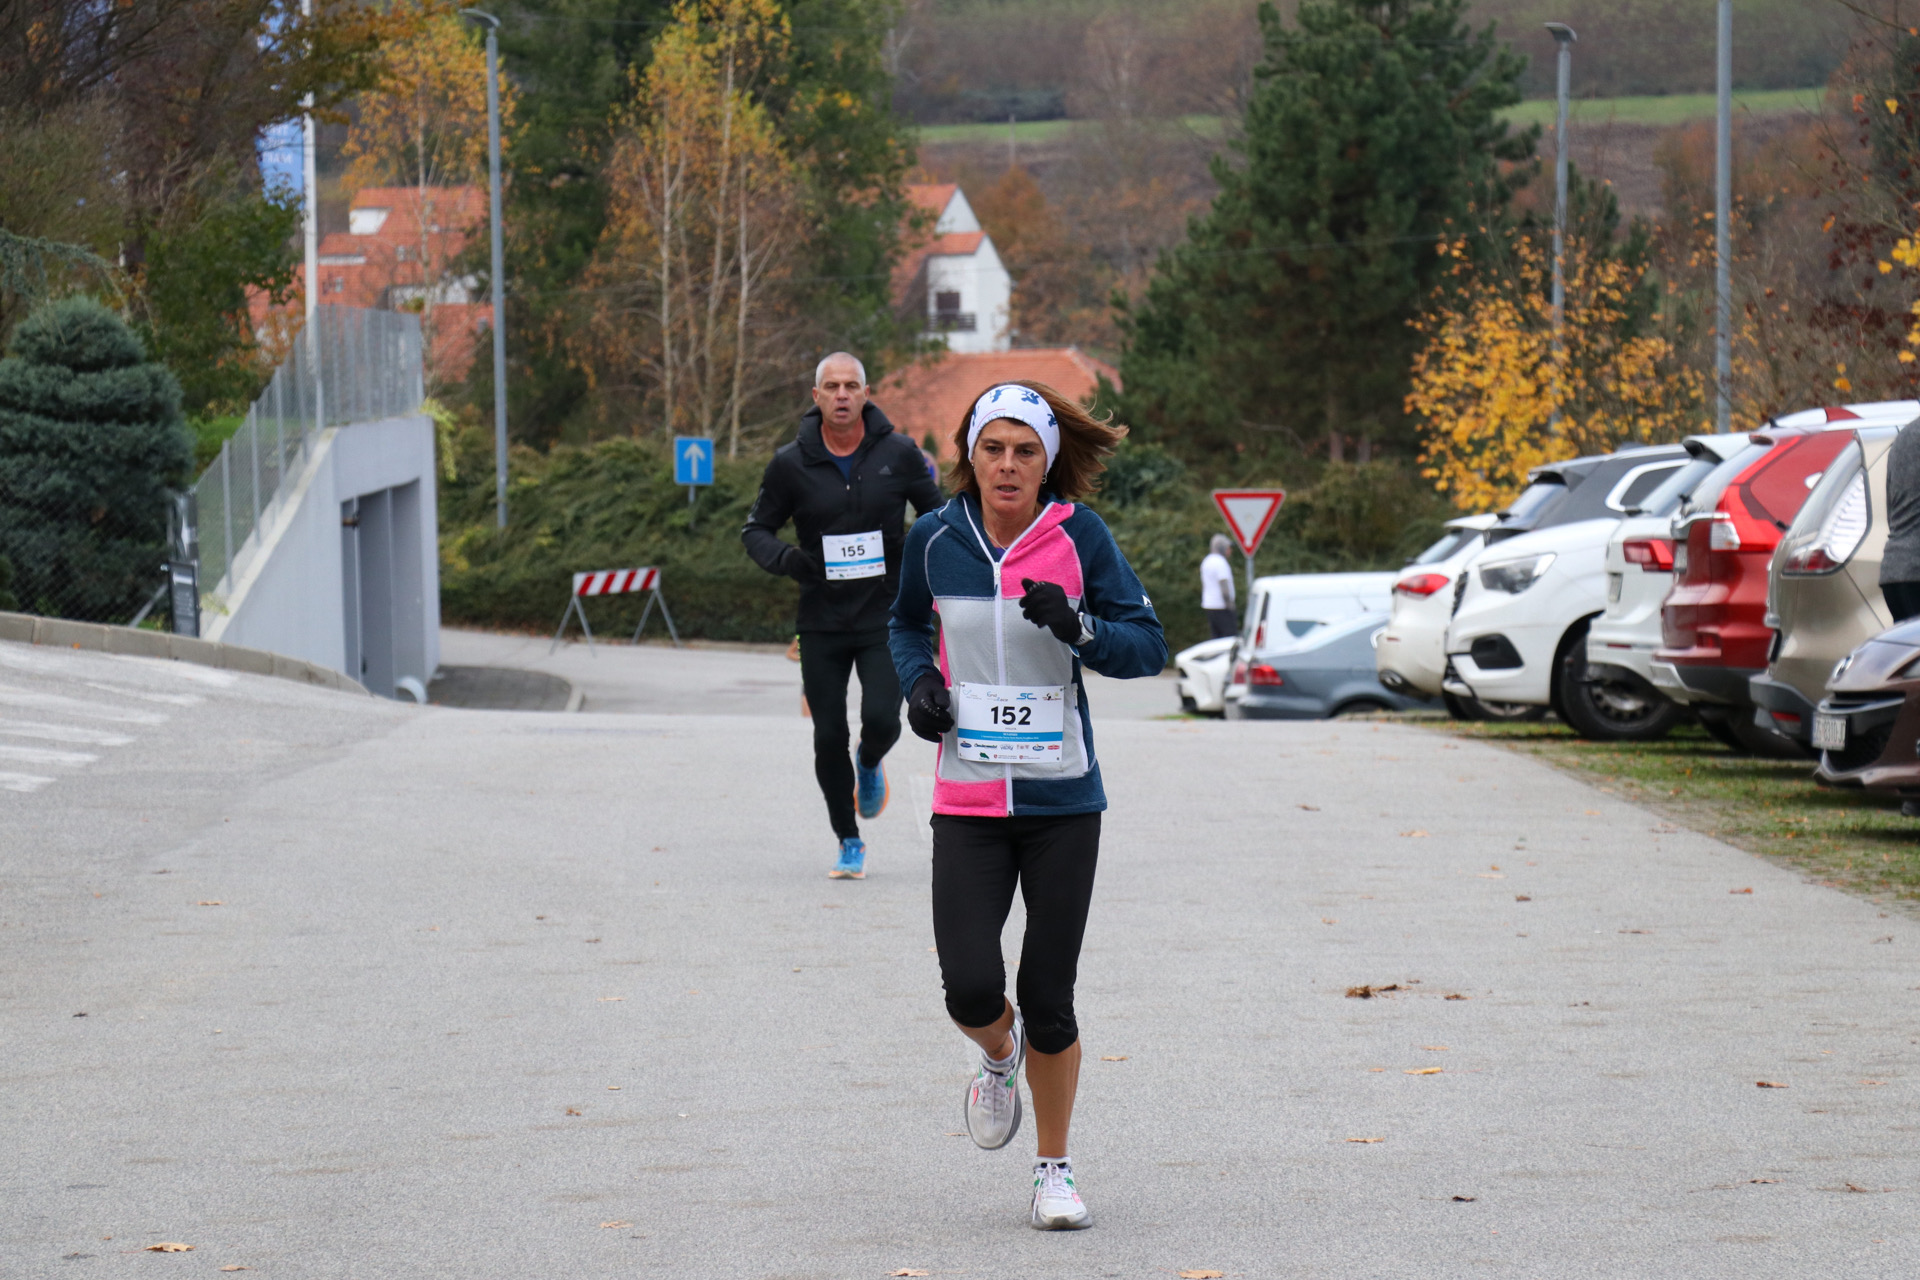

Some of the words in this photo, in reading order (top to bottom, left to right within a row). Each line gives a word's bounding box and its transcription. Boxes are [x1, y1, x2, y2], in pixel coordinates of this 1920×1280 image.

[841, 545, 866, 557] 155
[1016, 692, 1038, 700] SC
[990, 706, 1032, 725] 152
